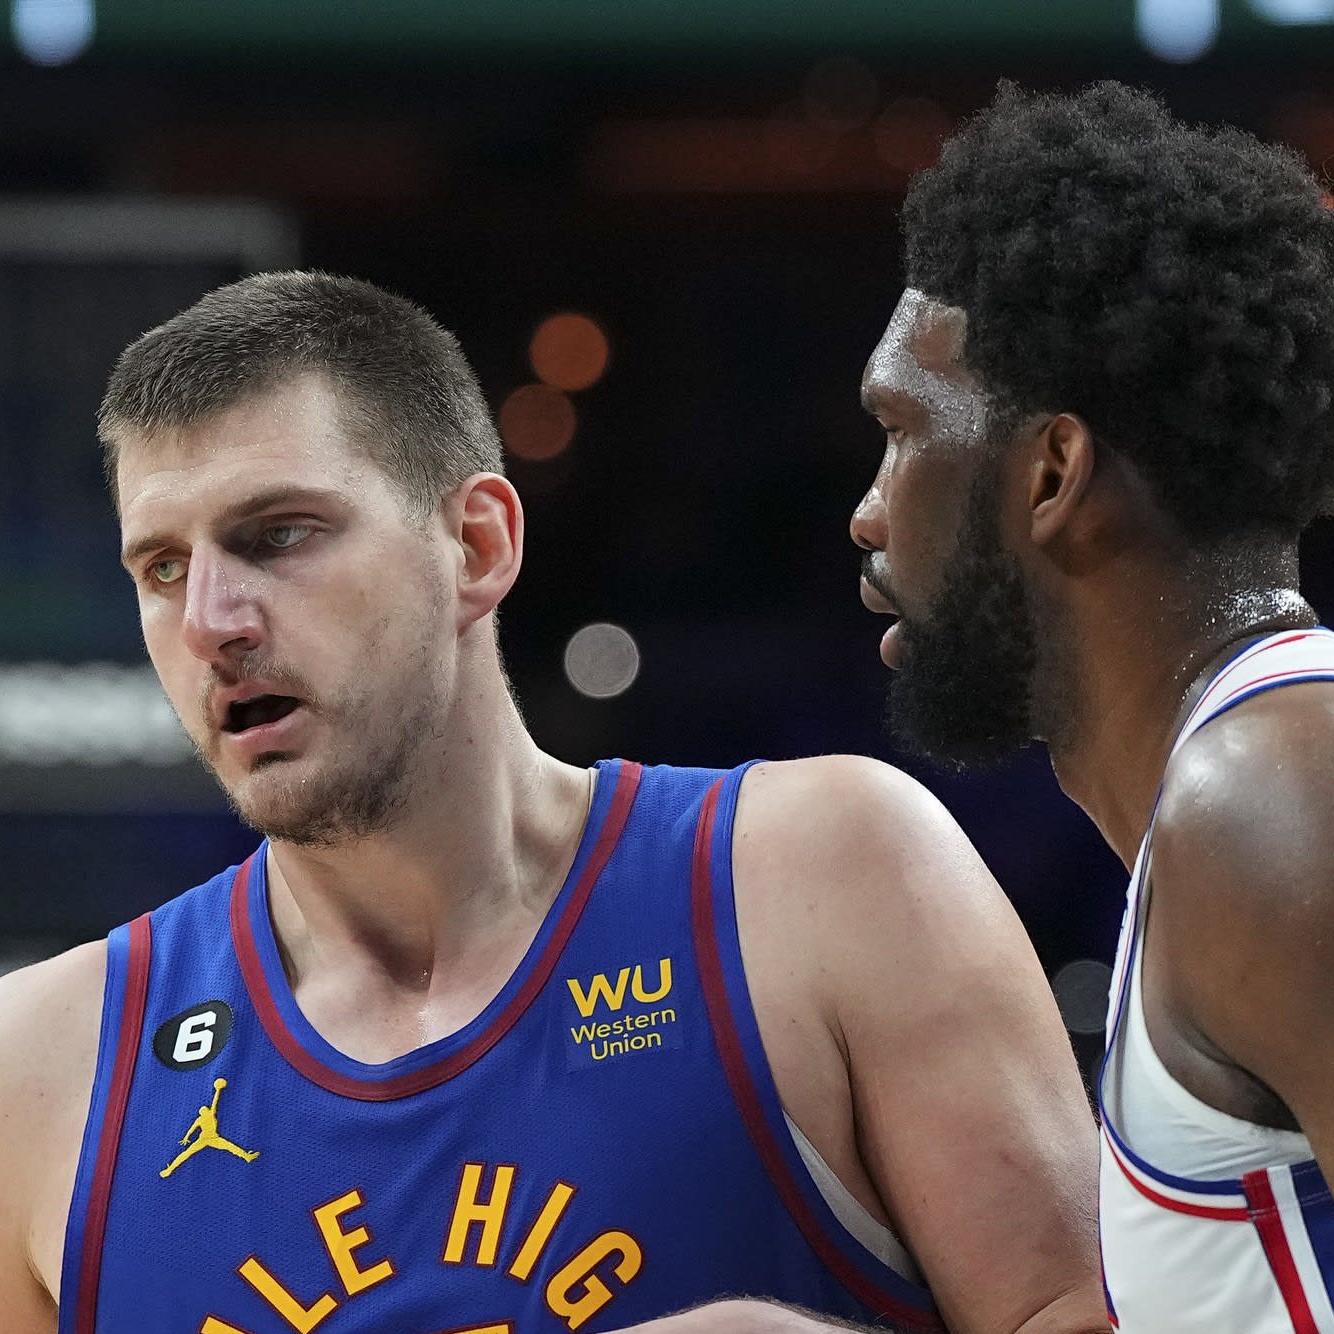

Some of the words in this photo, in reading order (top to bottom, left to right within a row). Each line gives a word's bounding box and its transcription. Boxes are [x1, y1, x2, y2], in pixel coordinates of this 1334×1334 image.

[566, 957, 673, 1018] WU
[172, 1010, 217, 1063] 6
[570, 1008, 676, 1044] Western
[590, 1032, 662, 1060] Union
[440, 1160, 645, 1333] HIG
